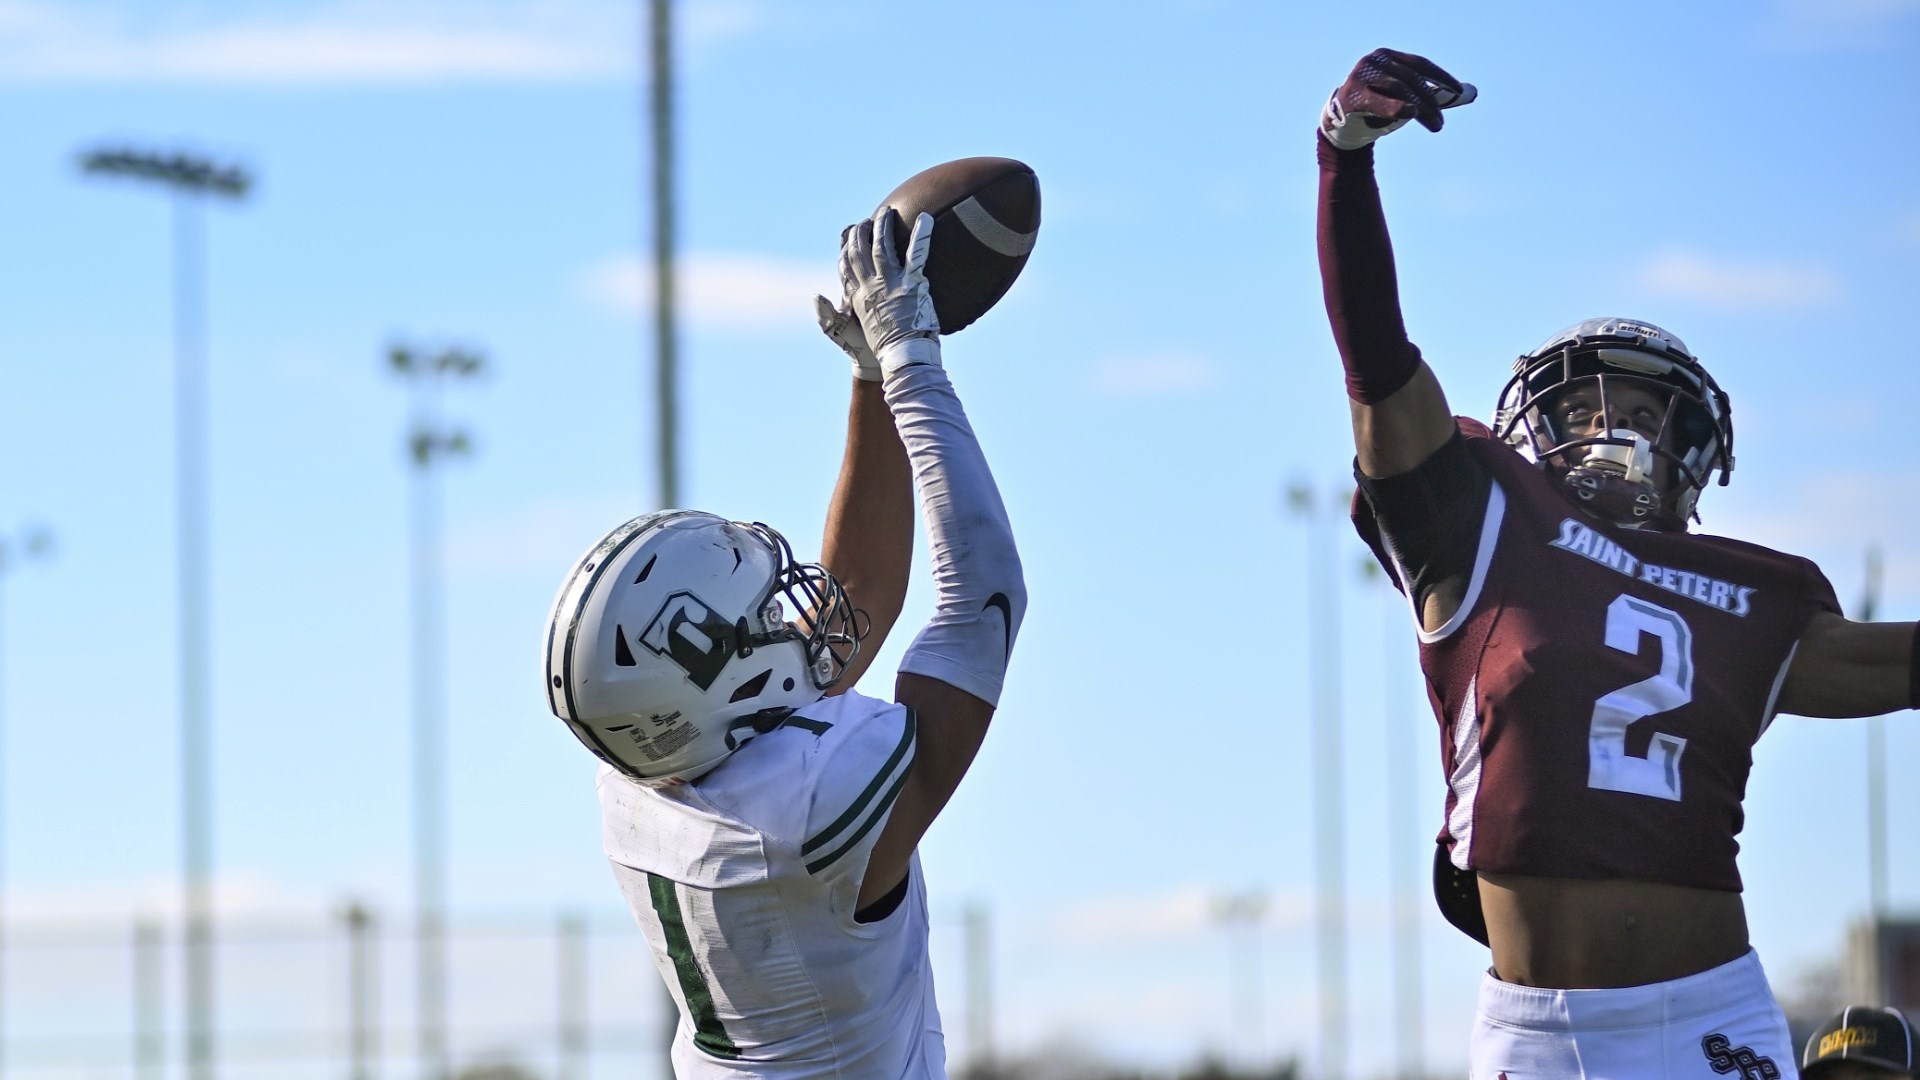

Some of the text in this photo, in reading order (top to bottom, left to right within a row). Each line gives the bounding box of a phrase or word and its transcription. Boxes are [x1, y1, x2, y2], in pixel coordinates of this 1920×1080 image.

[1548, 517, 1758, 618] SAINT PETER'S
[1588, 593, 1694, 802] 2
[647, 871, 742, 1060] 1
